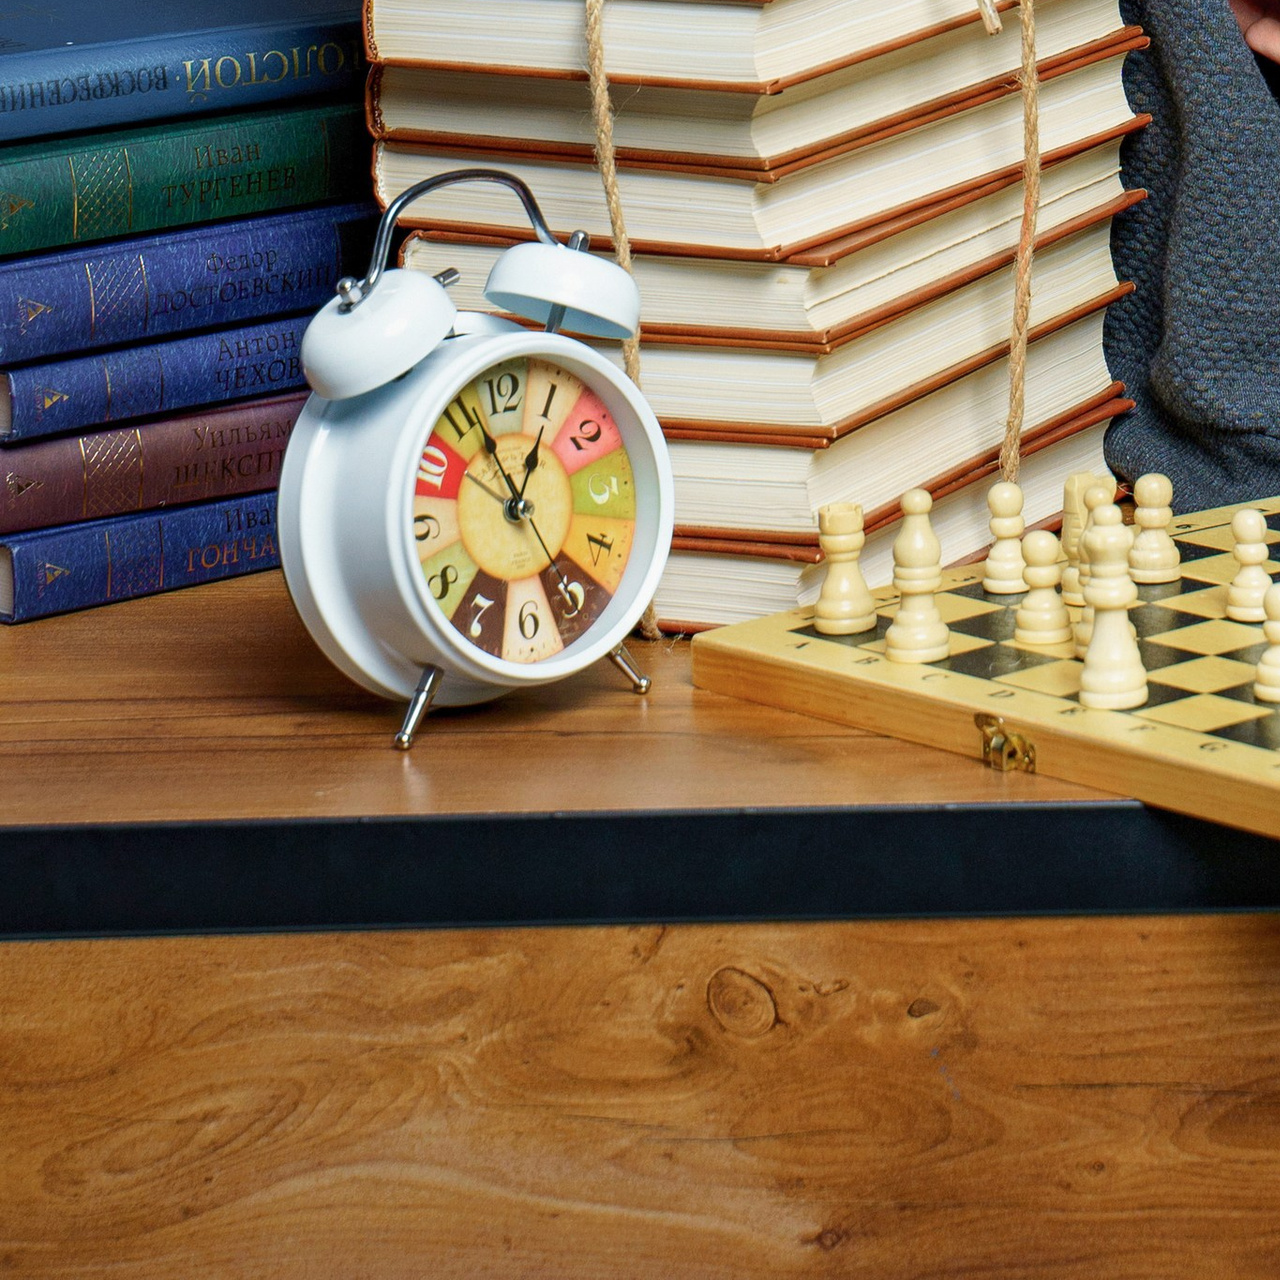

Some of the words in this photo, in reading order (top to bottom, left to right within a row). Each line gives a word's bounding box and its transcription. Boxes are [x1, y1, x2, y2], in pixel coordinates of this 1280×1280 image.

[194, 143, 261, 170] Иван
[162, 167, 297, 207] ТУРГЕНЕВ
[207, 249, 278, 275] Федор
[218, 331, 296, 362] Антон
[216, 357, 300, 391] ЧЕХОВ
[483, 373, 522, 417] 12
[538, 380, 558, 422] 1
[193, 420, 291, 451] Уильям
[443, 395, 479, 442] 11
[569, 420, 602, 451] 2
[416, 445, 448, 491] 10
[588, 474, 619, 505] 3
[225, 506, 277, 533] Ива
[187, 533, 276, 573] ГОНЧА
[586, 532, 615, 567] 4
[428, 564, 459, 600] 8
[557, 575, 586, 618] 5
[470, 593, 496, 638] 7
[518, 600, 541, 640] 6
